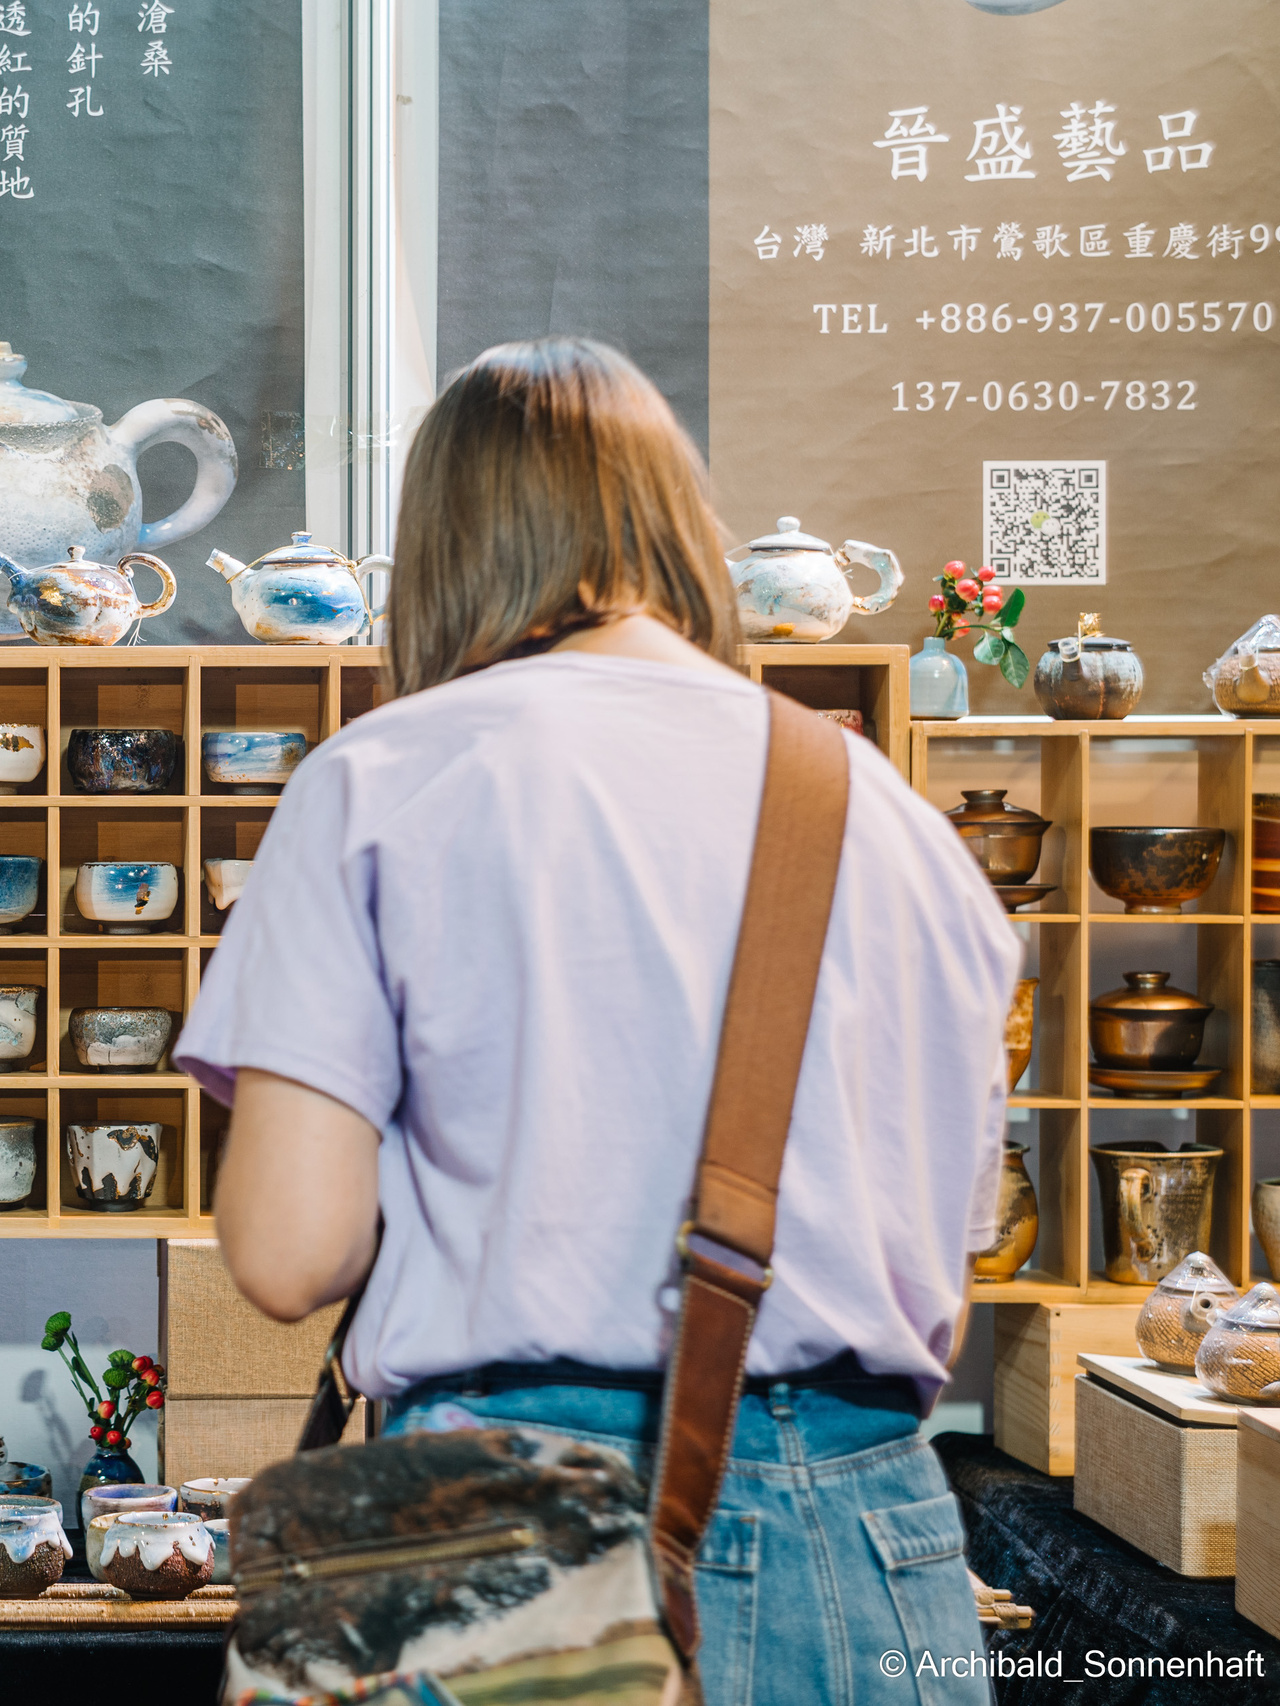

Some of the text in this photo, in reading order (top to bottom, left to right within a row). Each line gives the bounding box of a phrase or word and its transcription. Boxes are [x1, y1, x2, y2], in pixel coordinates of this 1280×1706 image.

[66, 1, 105, 118] 的針孔
[136, 0, 176, 78] 滄桑
[872, 100, 1215, 183] 晉盛藝品
[753, 221, 1280, 262] 台灣 新北市鶯歌區重慶街9
[812, 301, 1273, 334] TEL +886-937-005570
[892, 380, 1198, 411] 137-0630-7832
